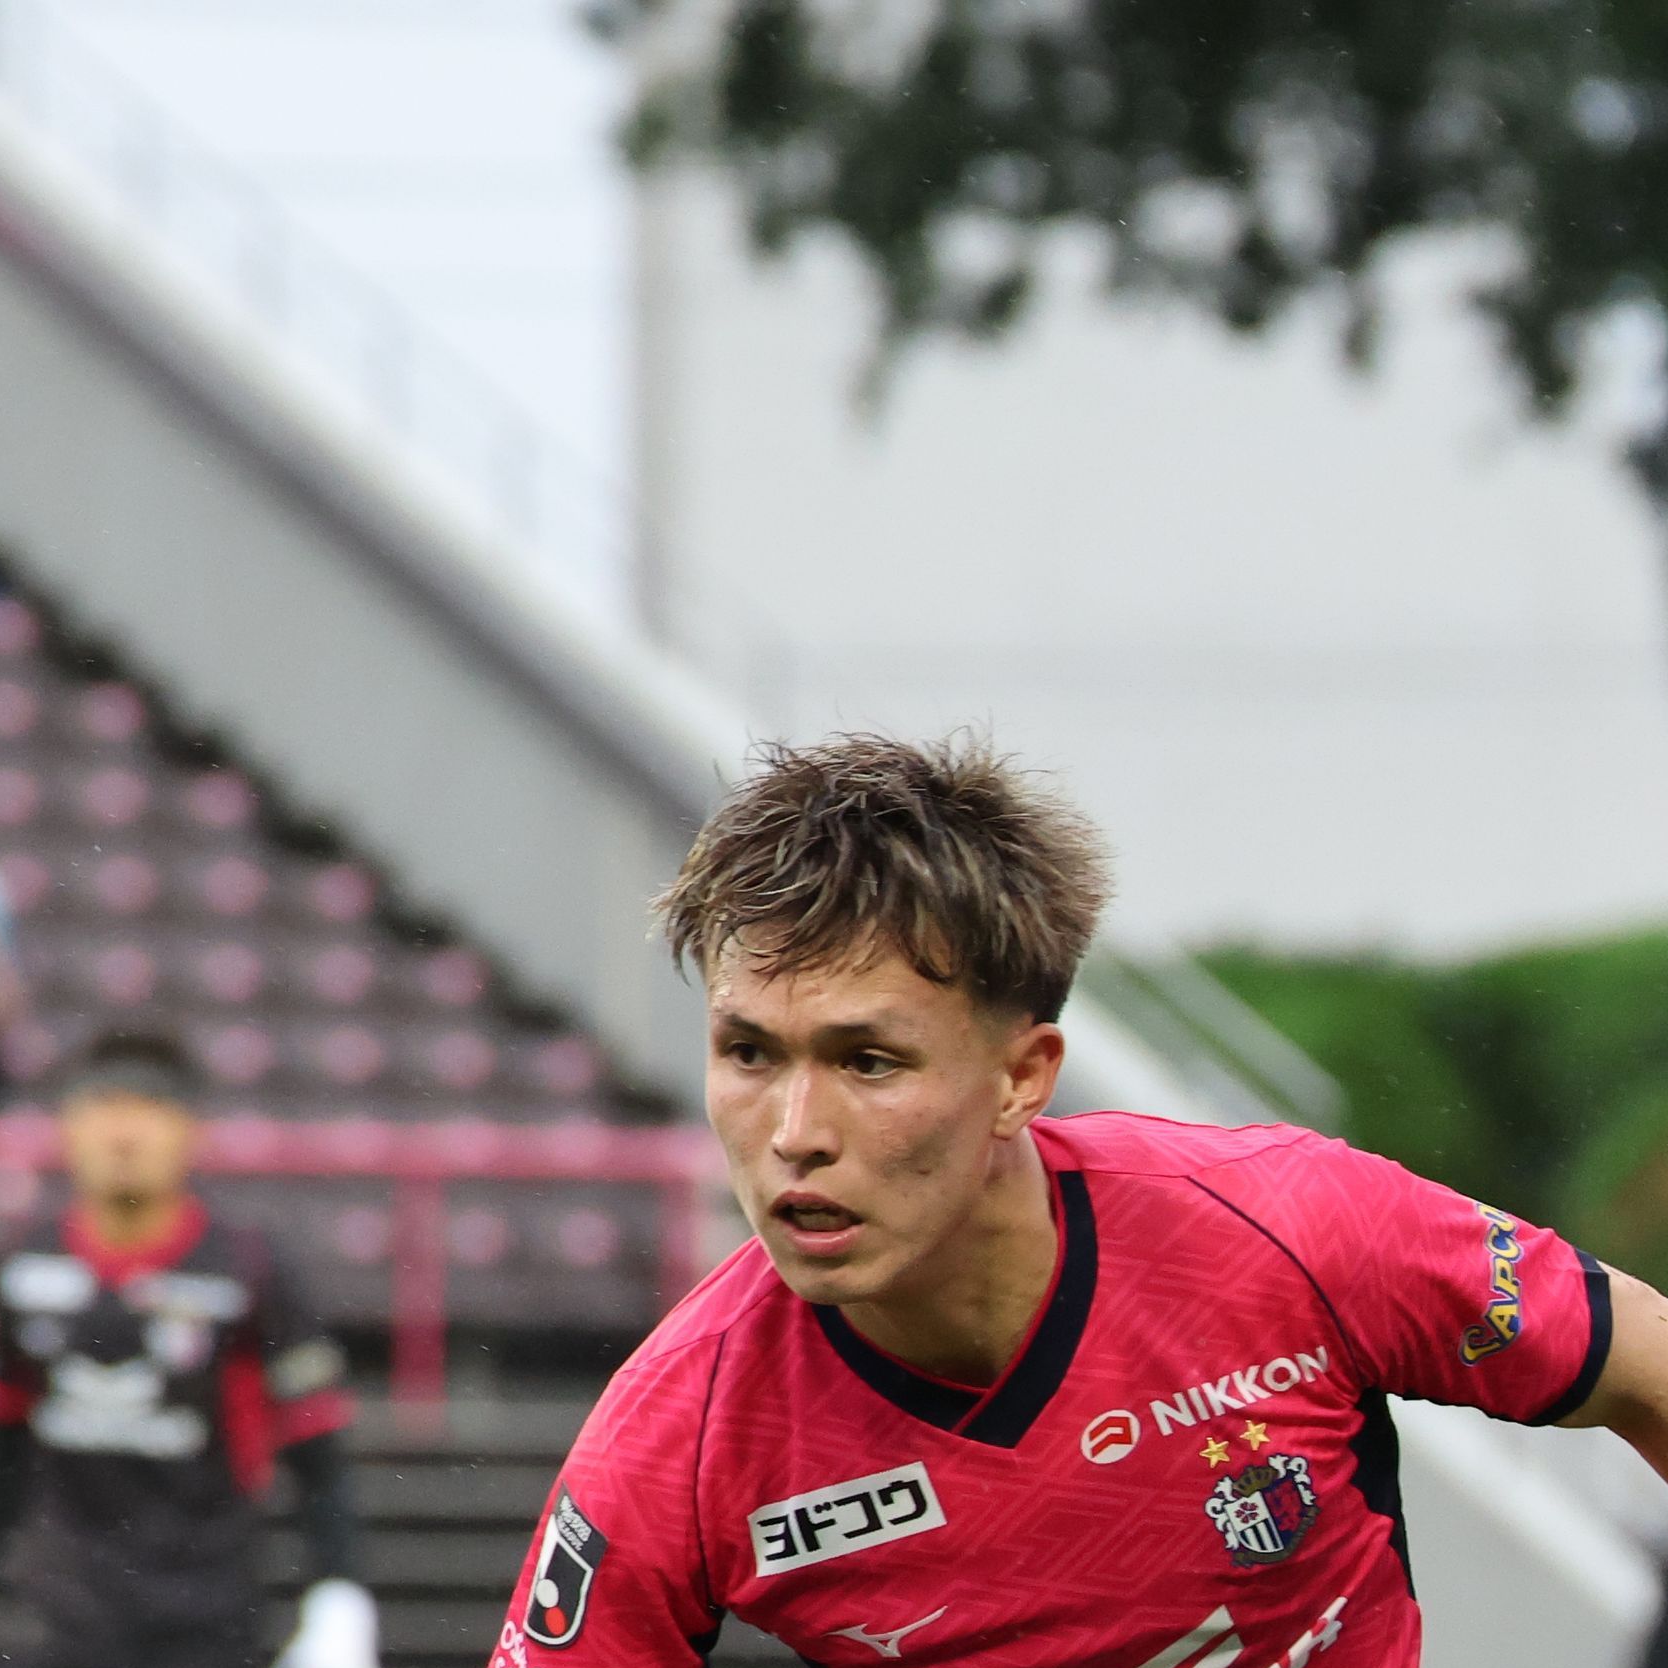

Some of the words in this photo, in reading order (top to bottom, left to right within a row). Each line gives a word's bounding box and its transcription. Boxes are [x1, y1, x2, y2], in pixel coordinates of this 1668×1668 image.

[1459, 1201, 1524, 1367] CAPCO
[1149, 1346, 1329, 1437] NIKKON
[757, 1479, 928, 1562] ヨドコウ
